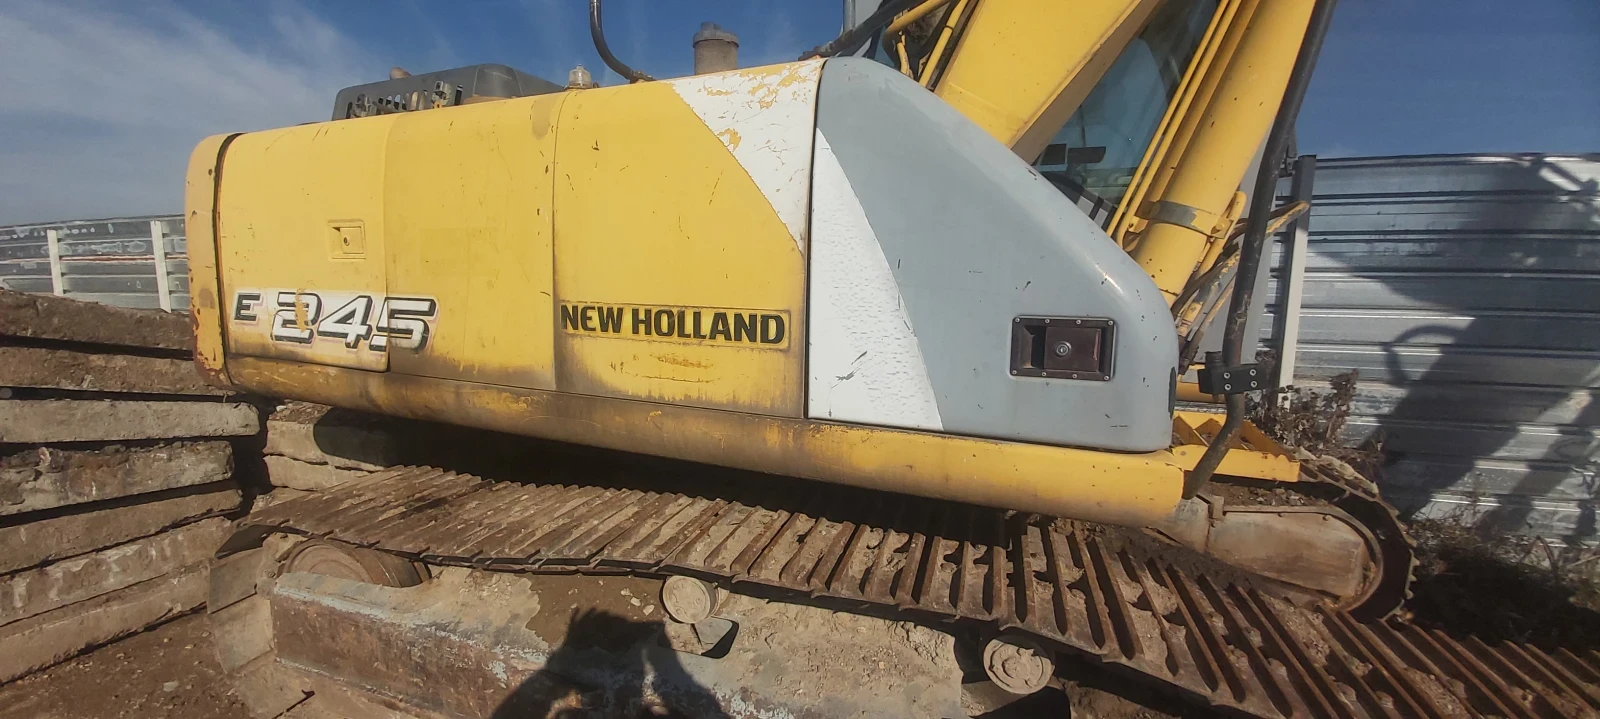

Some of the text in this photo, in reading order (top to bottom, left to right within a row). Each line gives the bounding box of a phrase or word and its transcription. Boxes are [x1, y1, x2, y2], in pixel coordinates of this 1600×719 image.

[234, 291, 437, 352] E 245
[560, 304, 785, 344] NEW HOLLAND
